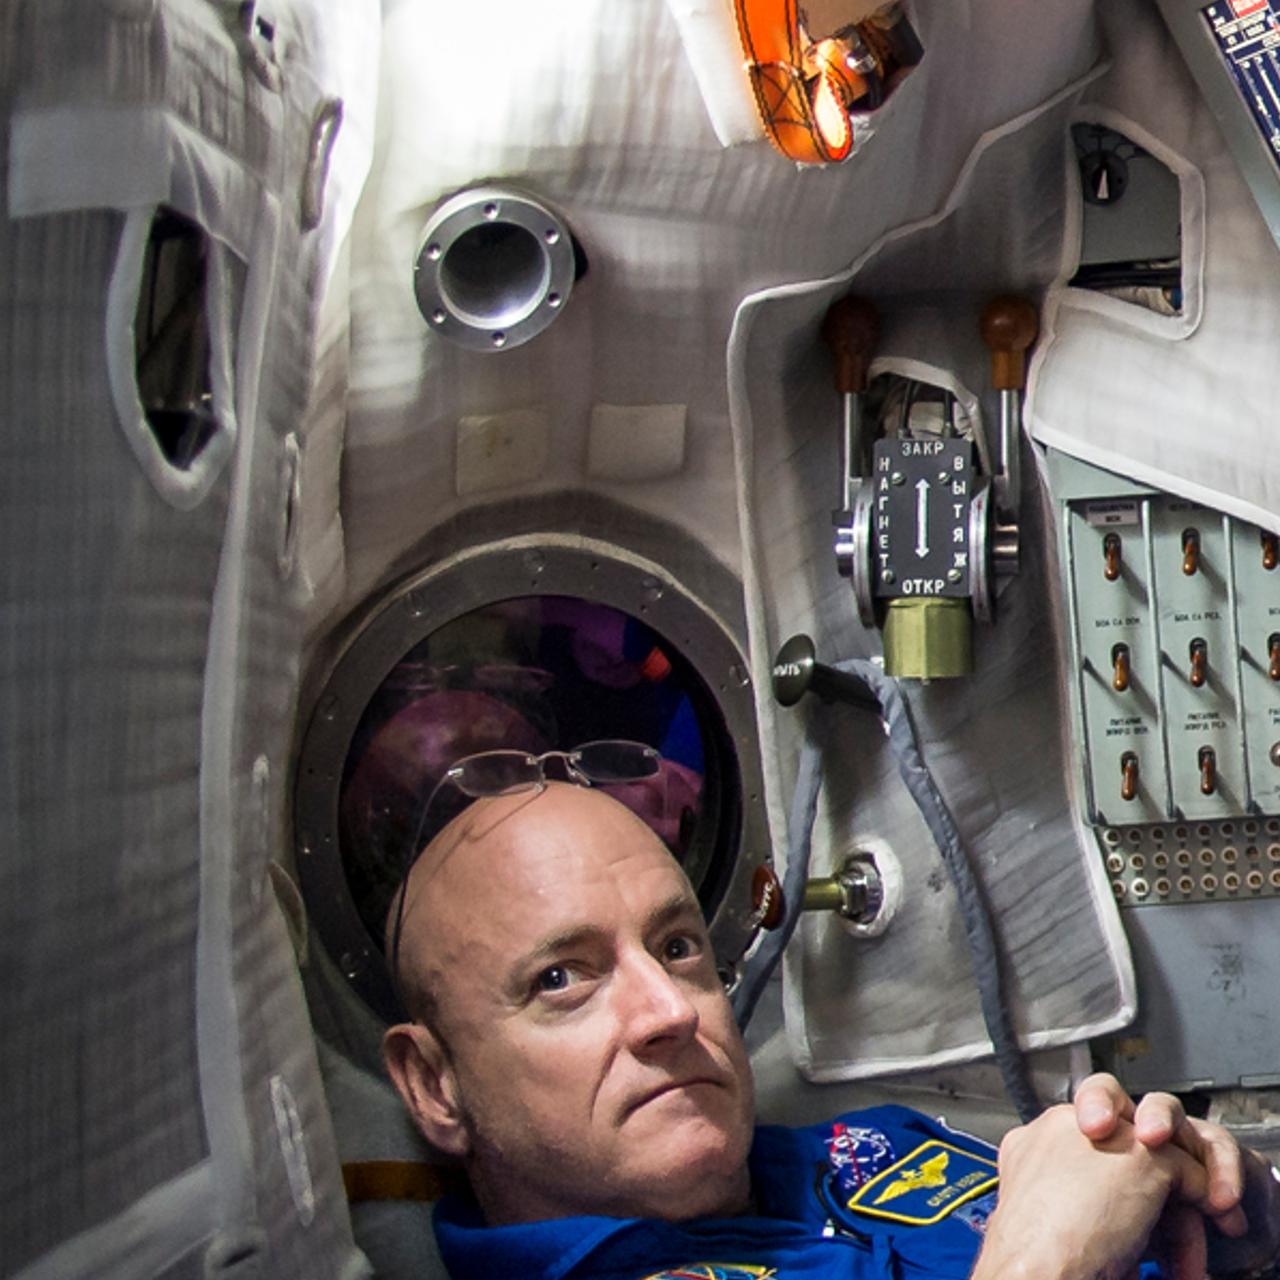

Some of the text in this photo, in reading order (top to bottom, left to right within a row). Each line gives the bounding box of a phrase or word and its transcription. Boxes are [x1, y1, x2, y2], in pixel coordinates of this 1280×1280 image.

[902, 442, 945, 456] ЗАКР
[878, 457, 891, 568] НАГНЕТ
[952, 456, 968, 568] ВЫТЯЖ
[902, 579, 945, 595] ОТКР
